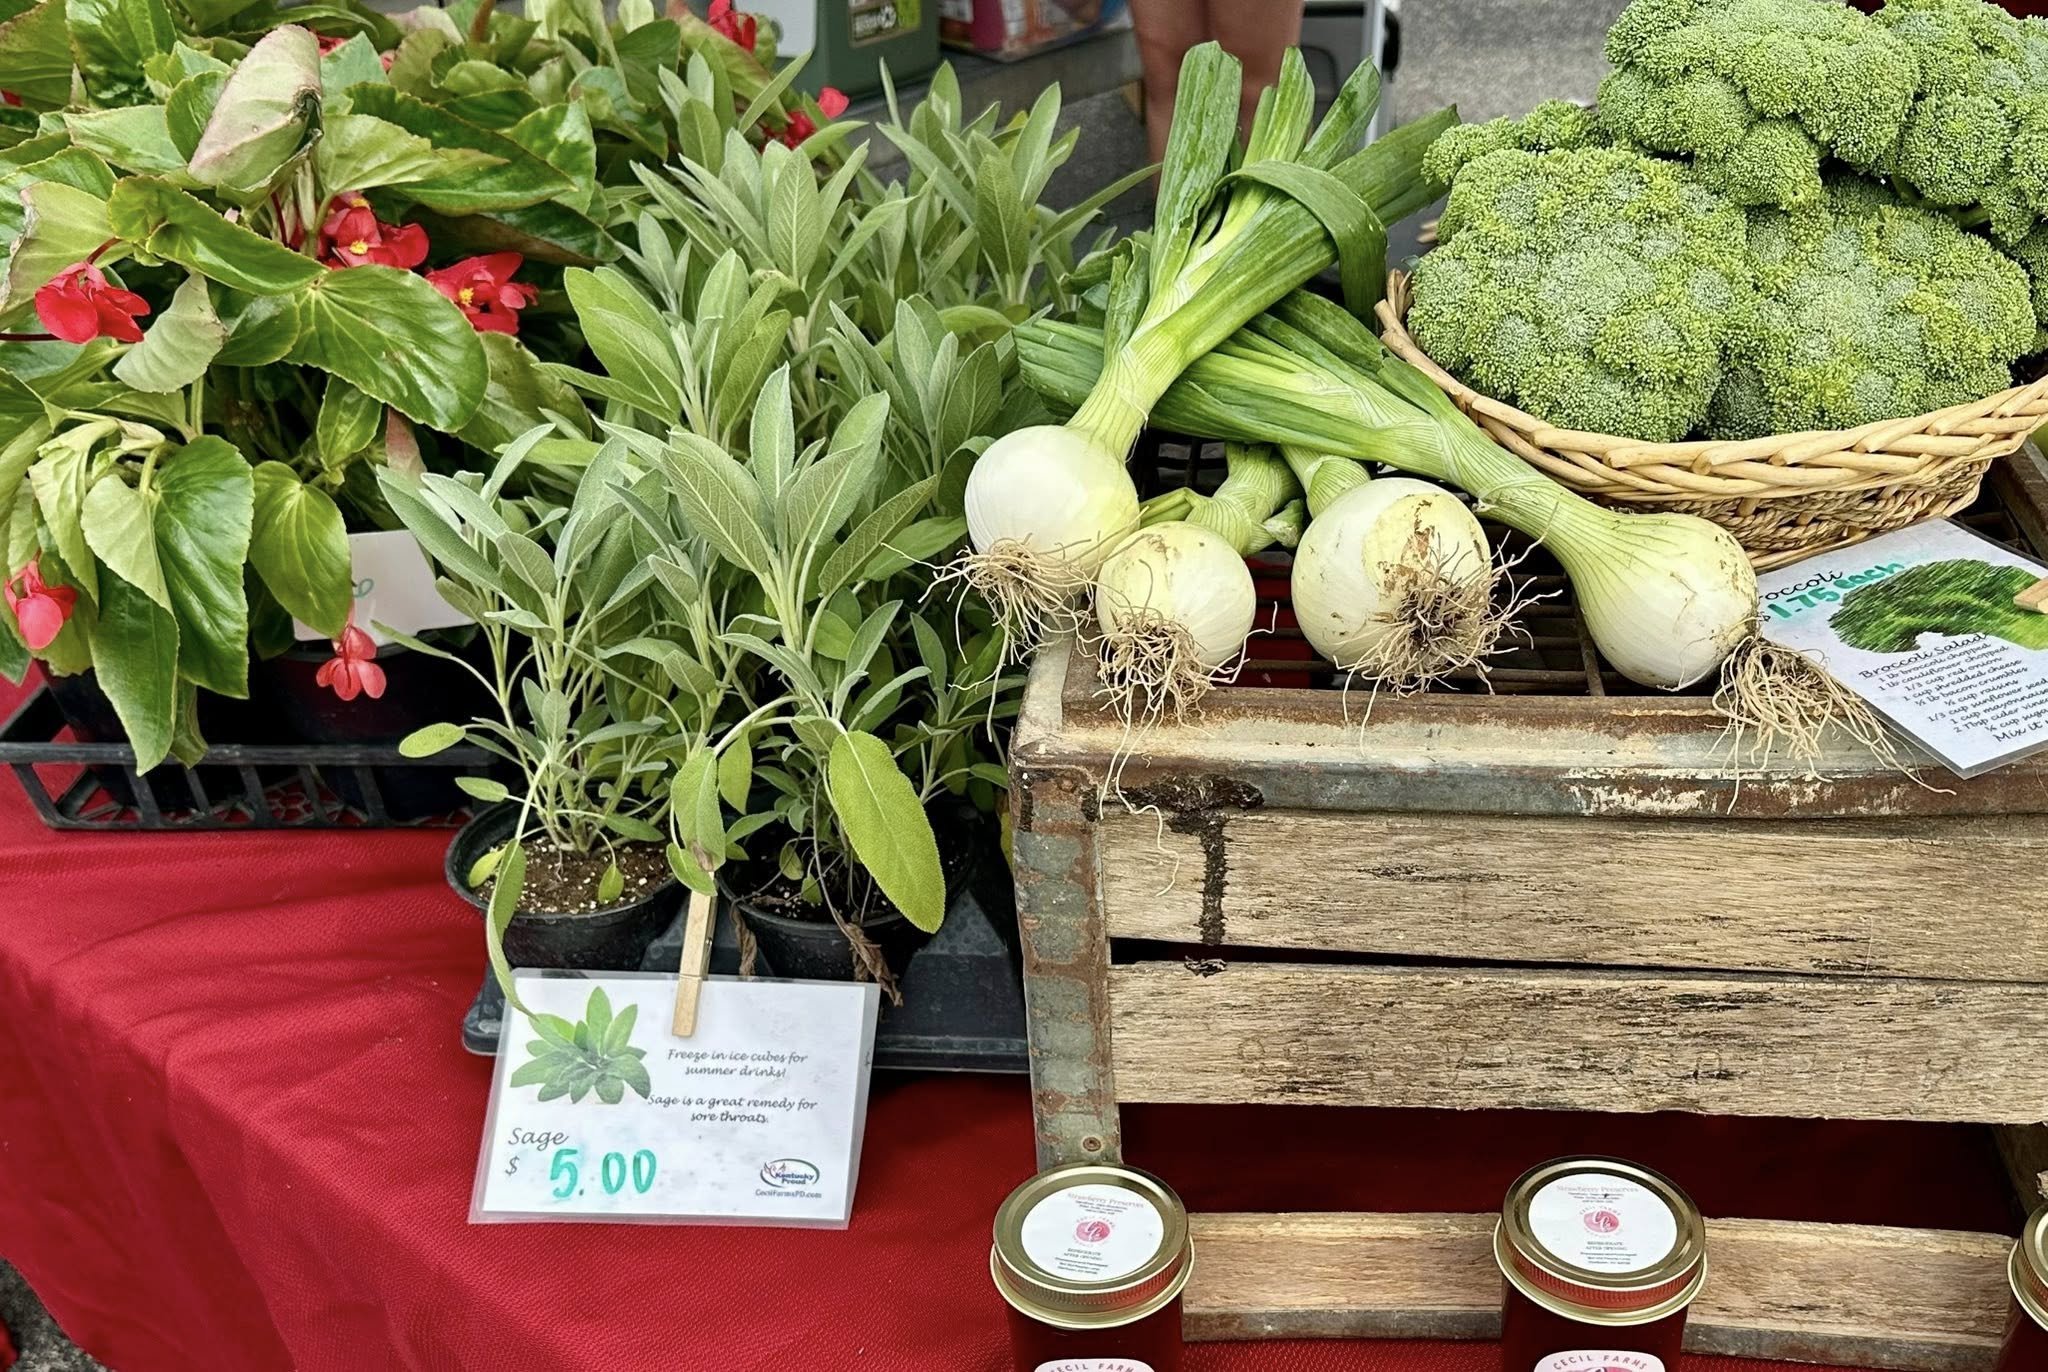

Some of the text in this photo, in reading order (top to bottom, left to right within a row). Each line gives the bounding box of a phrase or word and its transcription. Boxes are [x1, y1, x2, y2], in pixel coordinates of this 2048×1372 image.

[1833, 562, 1905, 589] each
[1858, 633, 1987, 679] Broccoli Salad
[1899, 658, 1946, 675] broccoli
[1947, 643, 1991, 659] chopped
[1902, 661, 1961, 684] cauliflower
[1965, 645, 2009, 662] chopped
[1904, 657, 2002, 692] 1/3 cup red onion
[1913, 689, 1933, 699] cup
[1934, 671, 1986, 691] shredded
[1987, 659, 2023, 674] cheese
[1940, 683, 1978, 698] bacon
[1978, 667, 2028, 686] crumbles
[1958, 693, 1978, 703] cup
[1980, 679, 2019, 695] raisins
[1928, 712, 1946, 722] 1/3
[1948, 705, 1969, 715] cup
[1971, 686, 2023, 708] sunflower
[1991, 708, 2019, 721] cider
[1960, 711, 1981, 721] cup
[2000, 718, 2020, 728] cup
[2022, 709, 2048, 721] suga
[1992, 727, 2027, 742] Mix
[2027, 721, 2043, 731] it
[668, 1049, 808, 1064] Freeze in ice cubes for
[685, 1065, 787, 1078] summer drinks!
[648, 1094, 818, 1112] Sage is a great remedy for
[690, 1111, 769, 1124] sore throats.
[508, 1127, 569, 1151] Sage
[504, 1148, 657, 1198] $ 5.00
[775, 1172, 814, 1181] Kentucky
[1050, 1363, 1088, 1372] ECIL
[1553, 1355, 1648, 1370] CECIL FARMS
